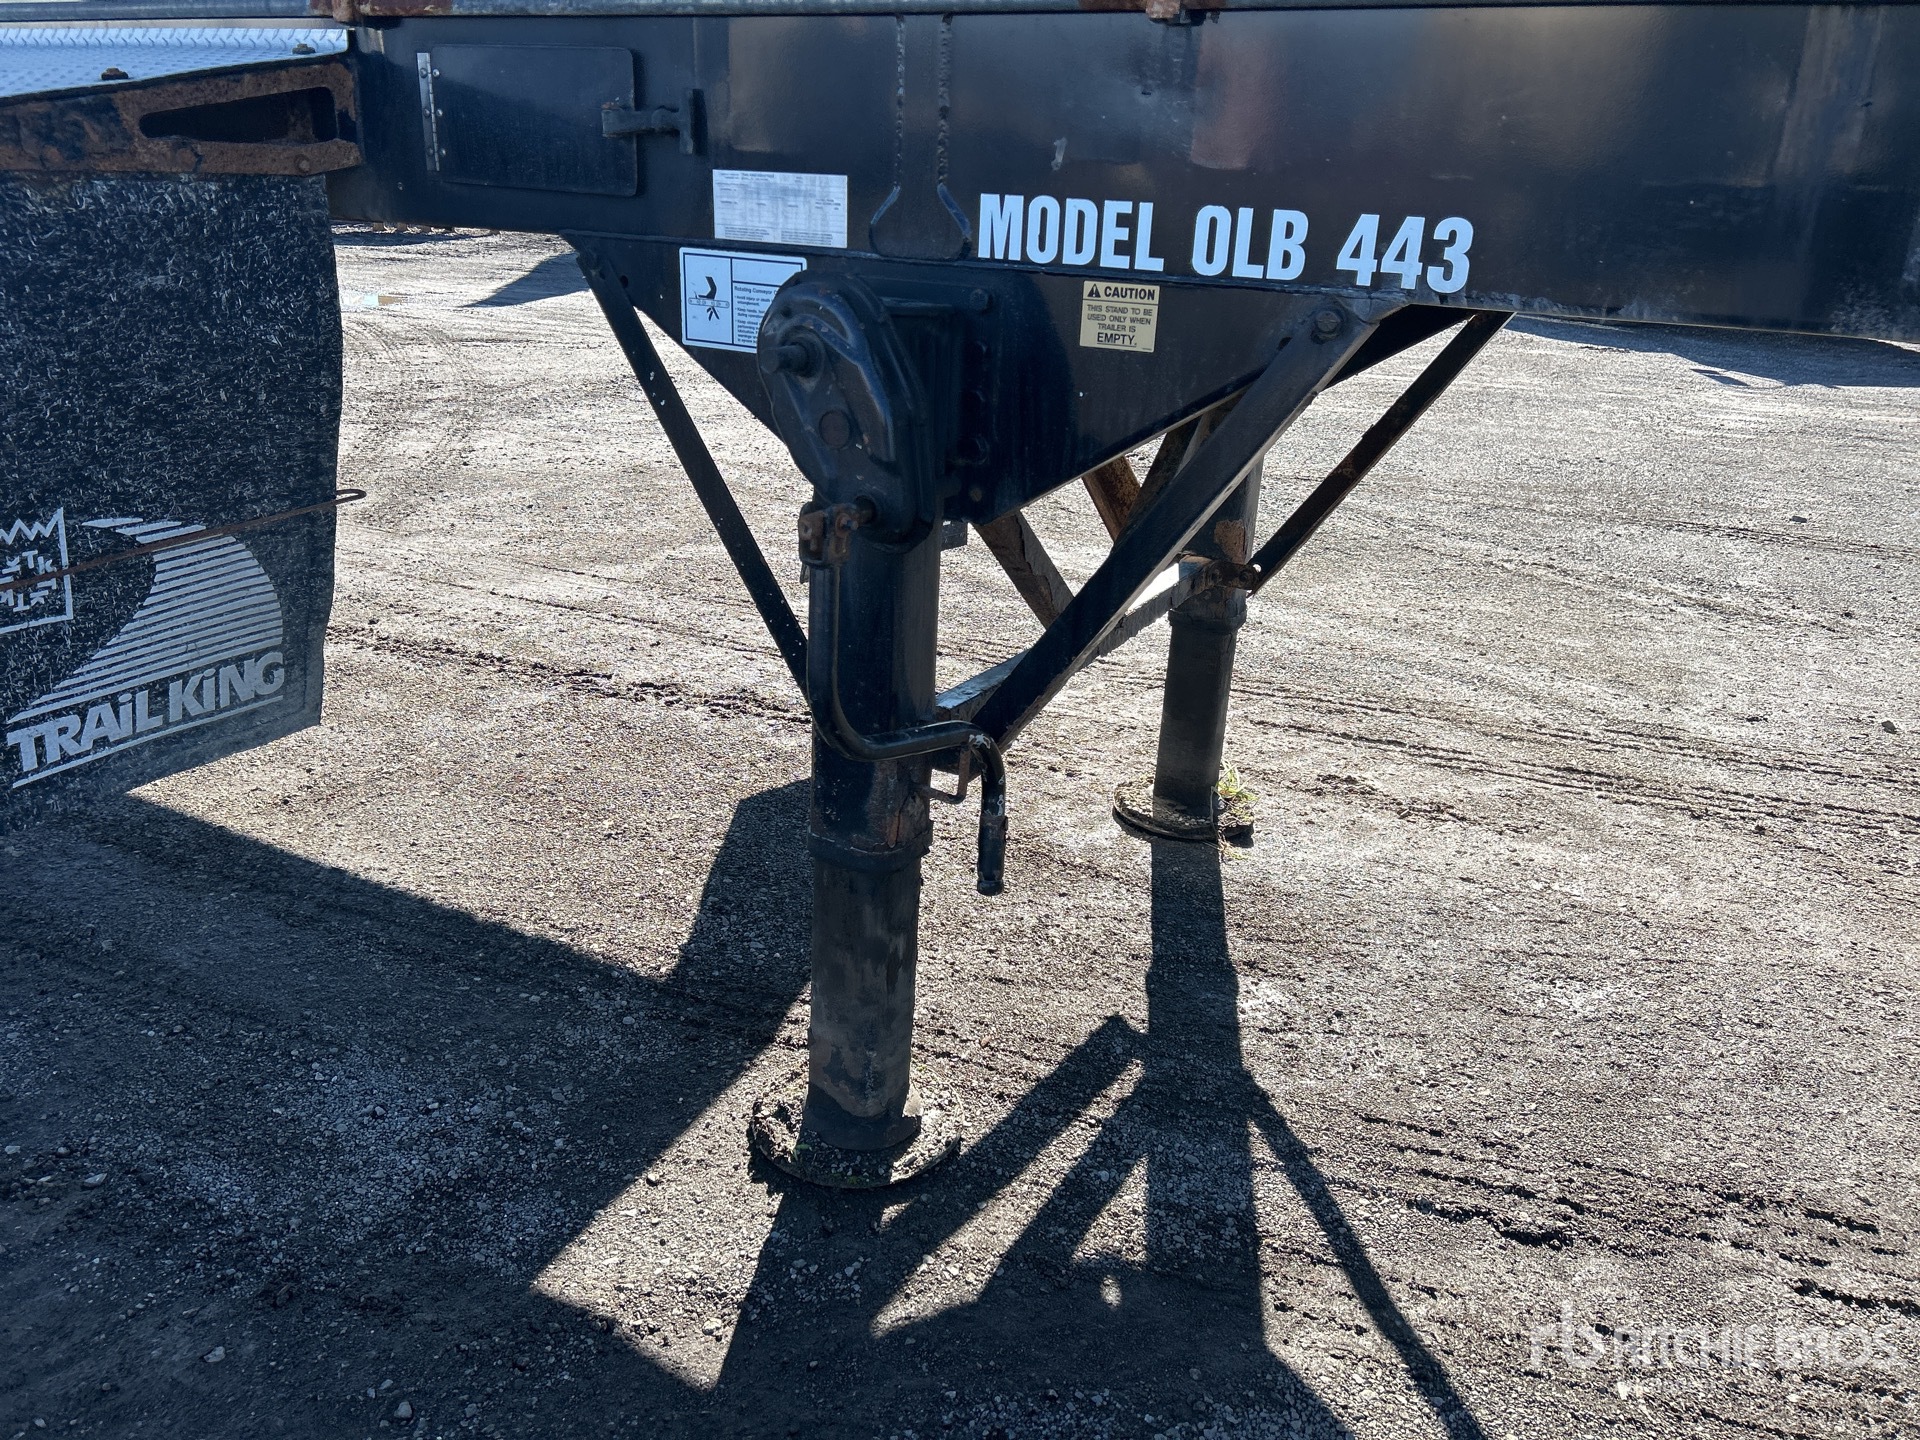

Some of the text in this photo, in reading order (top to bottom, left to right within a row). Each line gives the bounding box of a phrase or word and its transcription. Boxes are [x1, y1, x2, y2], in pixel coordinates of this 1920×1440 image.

[977, 193, 1475, 294] MODEL OLB 443
[1104, 286, 1155, 300] CAUTION
[1087, 304, 1153, 316] THIS STAND TO BE
[1087, 313, 1151, 325] USED ONLY WHEN
[1098, 323, 1136, 333] TRAILER IS
[1097, 332, 1137, 346] EMPTY.
